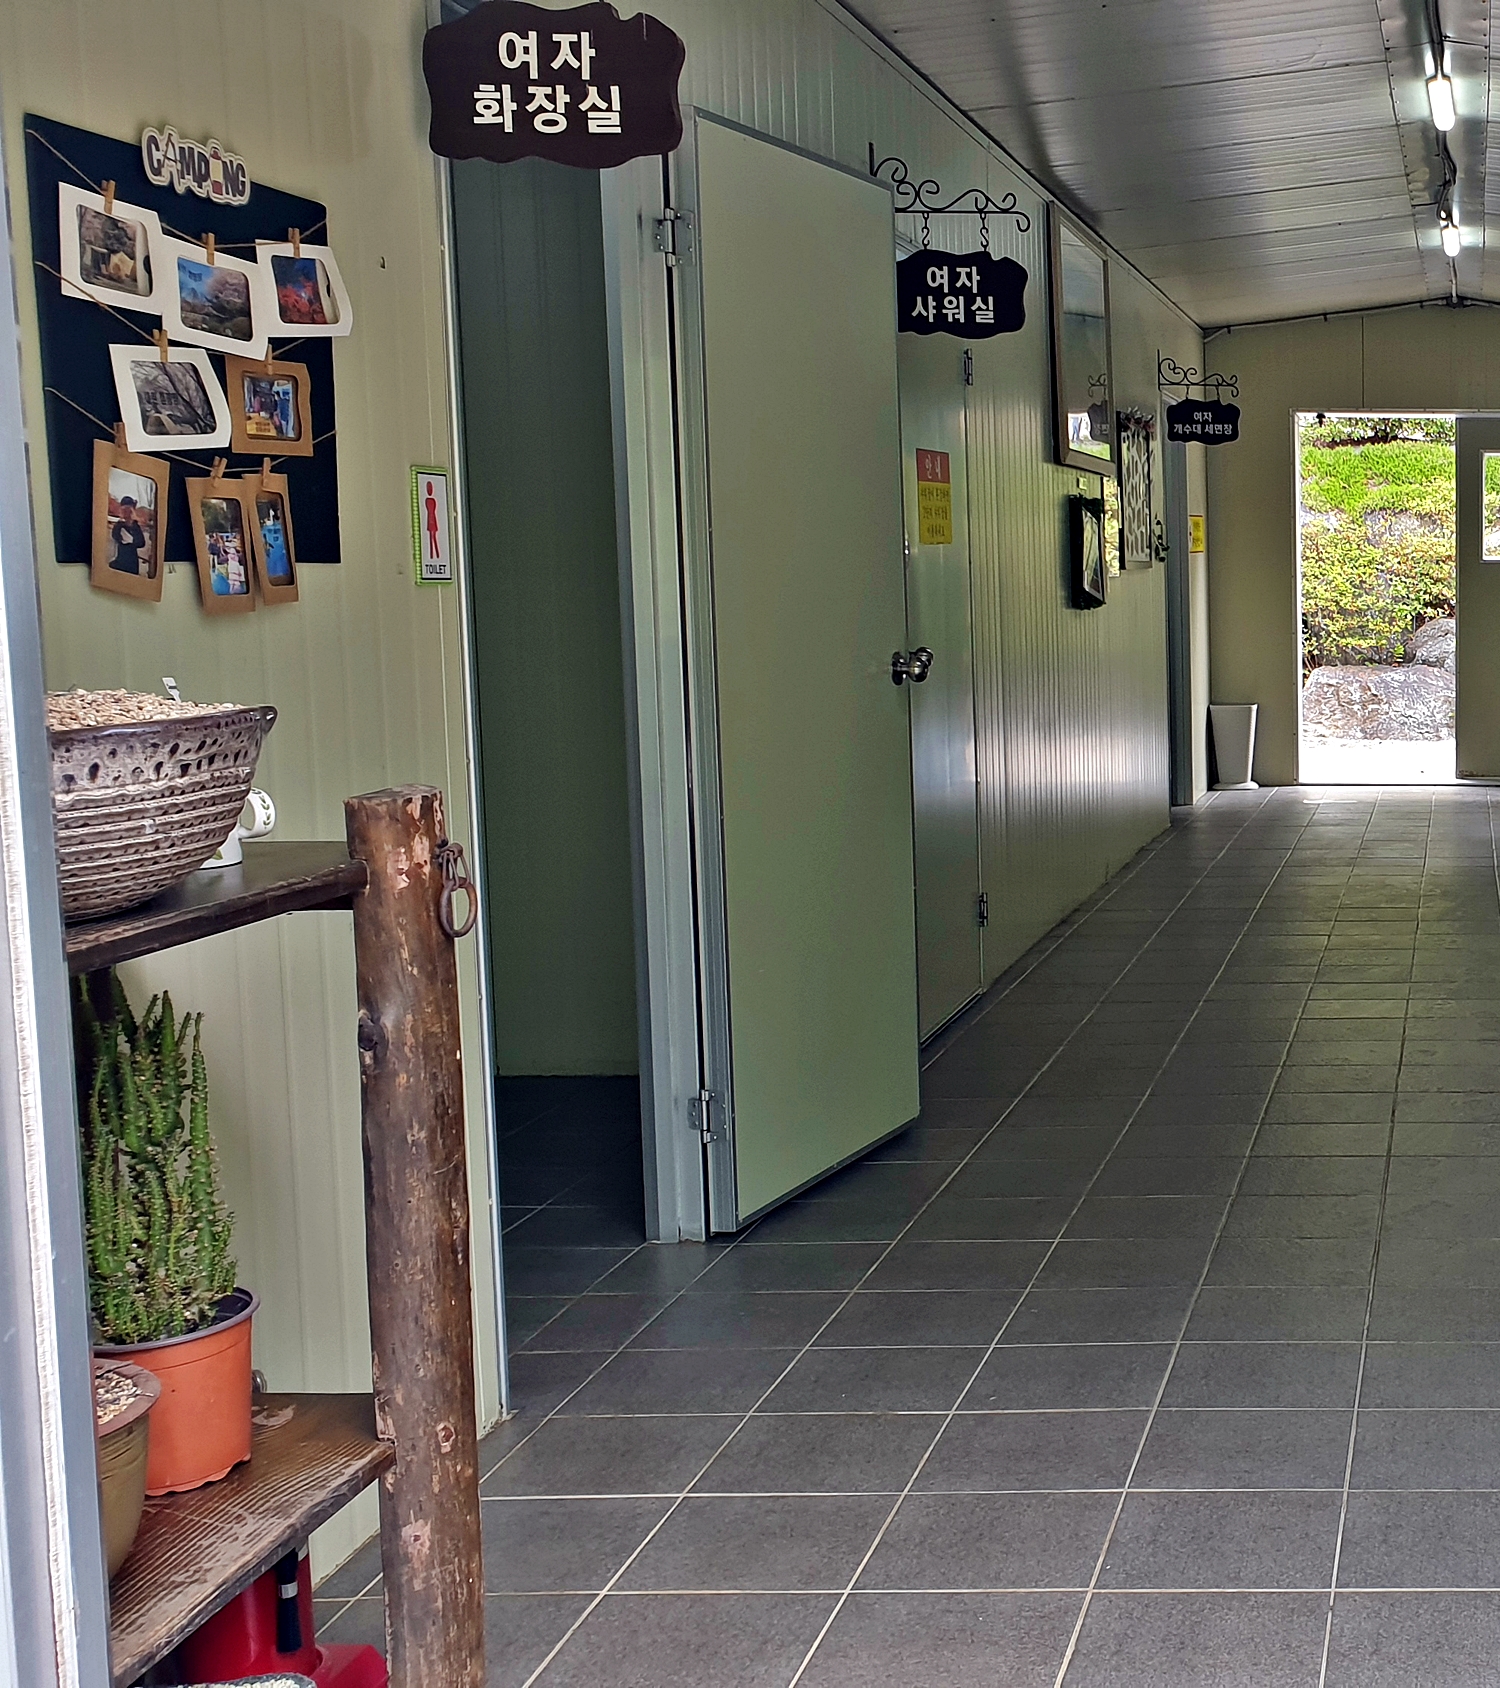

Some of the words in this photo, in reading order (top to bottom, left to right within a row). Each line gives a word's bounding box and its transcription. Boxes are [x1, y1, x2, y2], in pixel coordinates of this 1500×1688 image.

[498, 30, 596, 80] 여자
[473, 83, 622, 134] 화장실
[146, 132, 247, 198] CAMPING
[926, 265, 980, 293] 여자
[911, 295, 995, 323] 샤워실
[1173, 423, 1202, 435] 개수대
[1204, 423, 1233, 436] 세면장
[1193, 411, 1213, 423] 여자
[425, 564, 447, 575] TOILET
